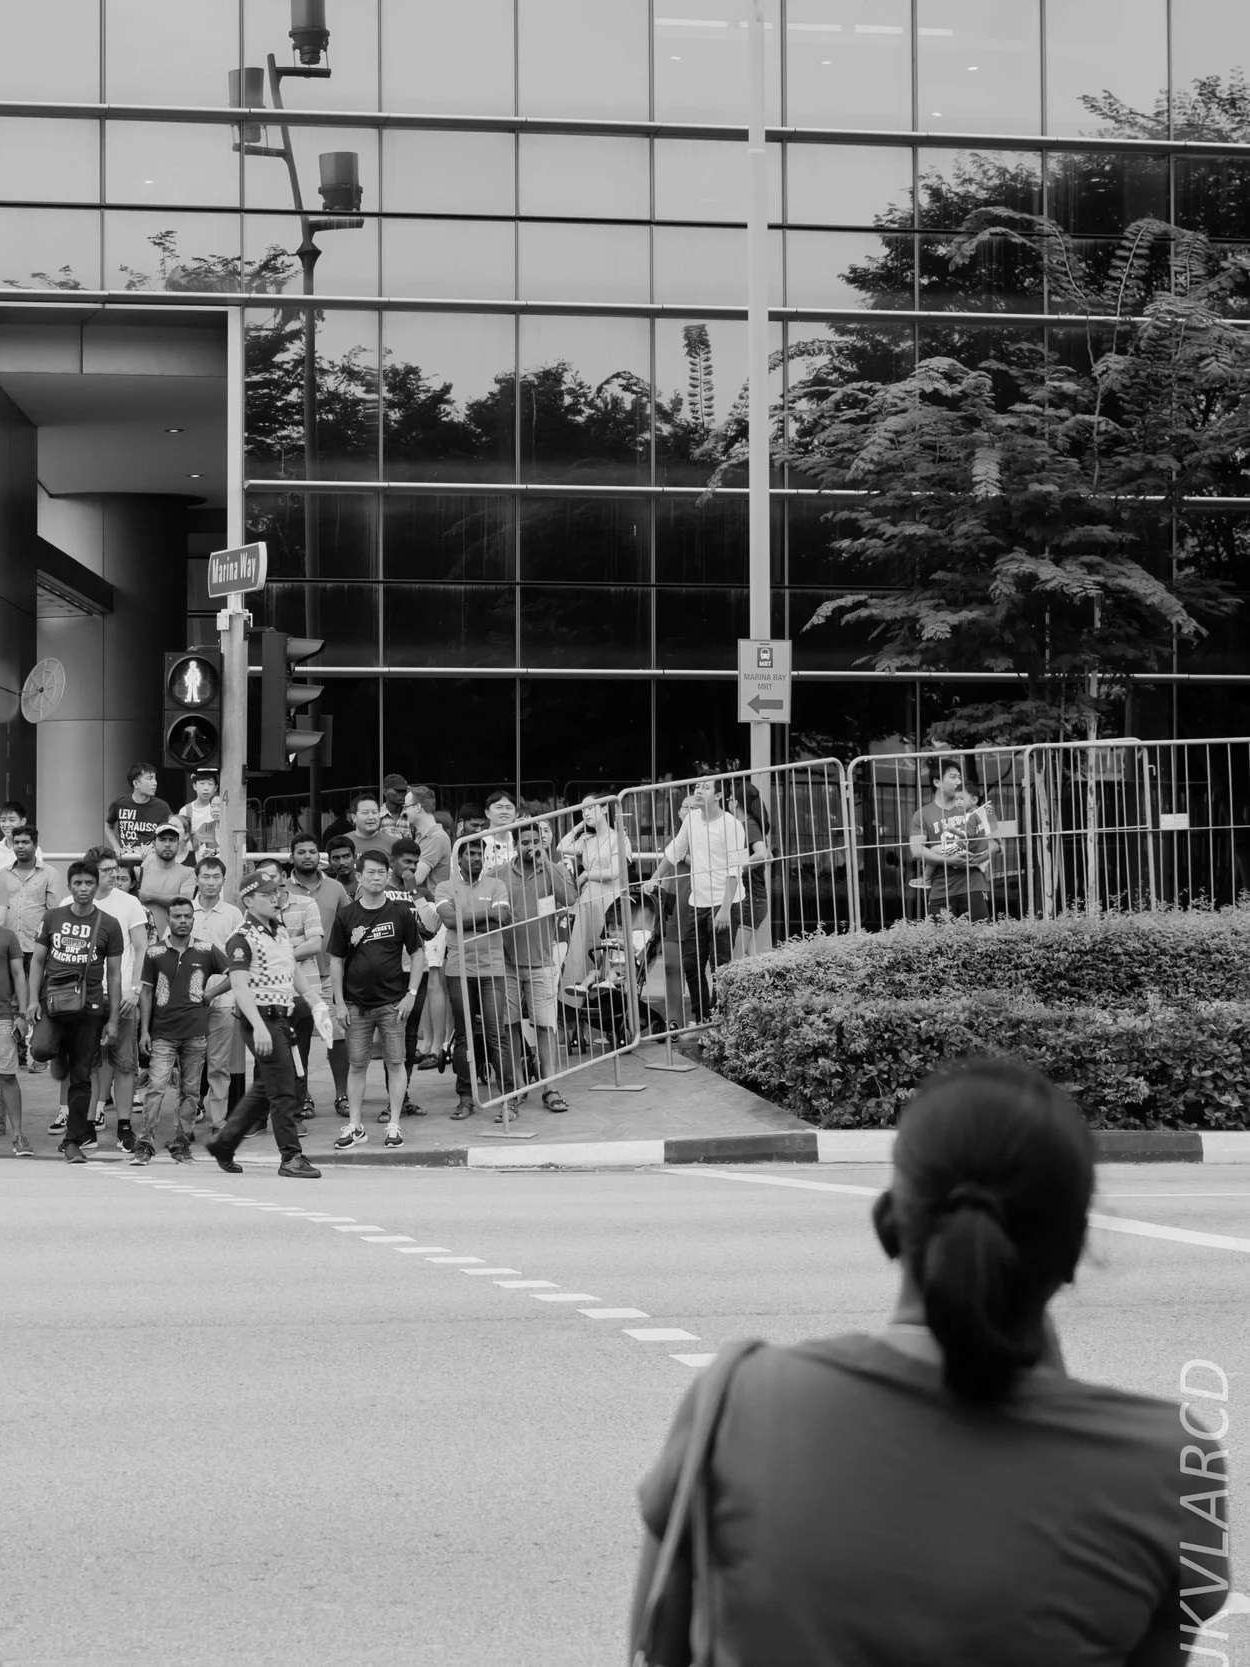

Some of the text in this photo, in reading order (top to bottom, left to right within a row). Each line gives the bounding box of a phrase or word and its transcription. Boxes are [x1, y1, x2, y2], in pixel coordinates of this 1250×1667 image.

[211, 551, 257, 585] Marina Way
[743, 673, 772, 681] MARINA
[222, 789, 229, 806] 4
[118, 808, 137, 820] LEVI
[119, 820, 158, 832] STRAUSS
[60, 921, 92, 938] S&D
[61, 937, 86, 947] SUPER
[65, 946, 81, 954] DRY
